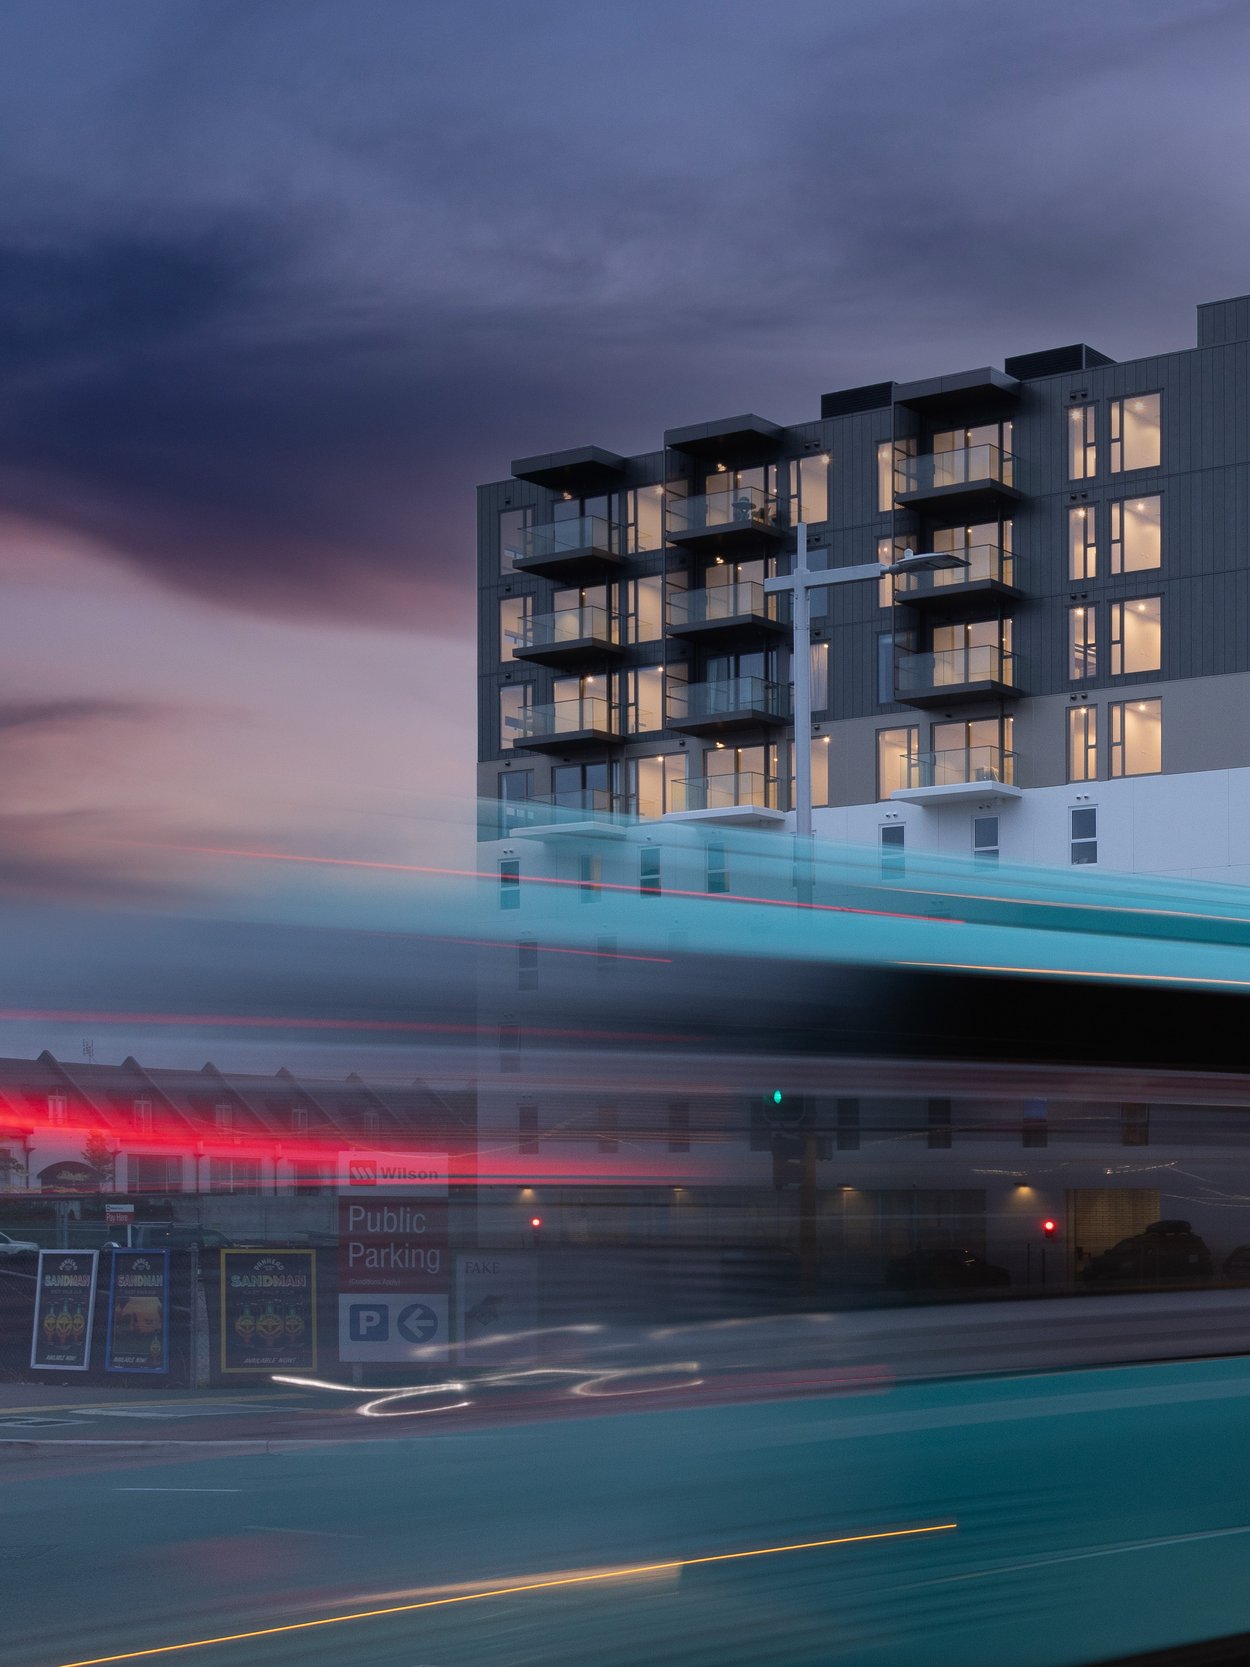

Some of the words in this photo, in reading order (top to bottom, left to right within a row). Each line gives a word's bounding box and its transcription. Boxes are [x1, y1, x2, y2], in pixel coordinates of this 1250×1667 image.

[380, 1166, 438, 1180] Wilson
[106, 1213, 116, 1223] Pay
[116, 1213, 128, 1222] Here
[348, 1205, 426, 1234] Public
[348, 1241, 441, 1274] Parking
[465, 1261, 501, 1274] FAKE
[44, 1275, 90, 1287] SANDMAN
[117, 1275, 163, 1287] SANDMAN
[231, 1275, 306, 1287] SANDMAN
[359, 1310, 381, 1335] P
